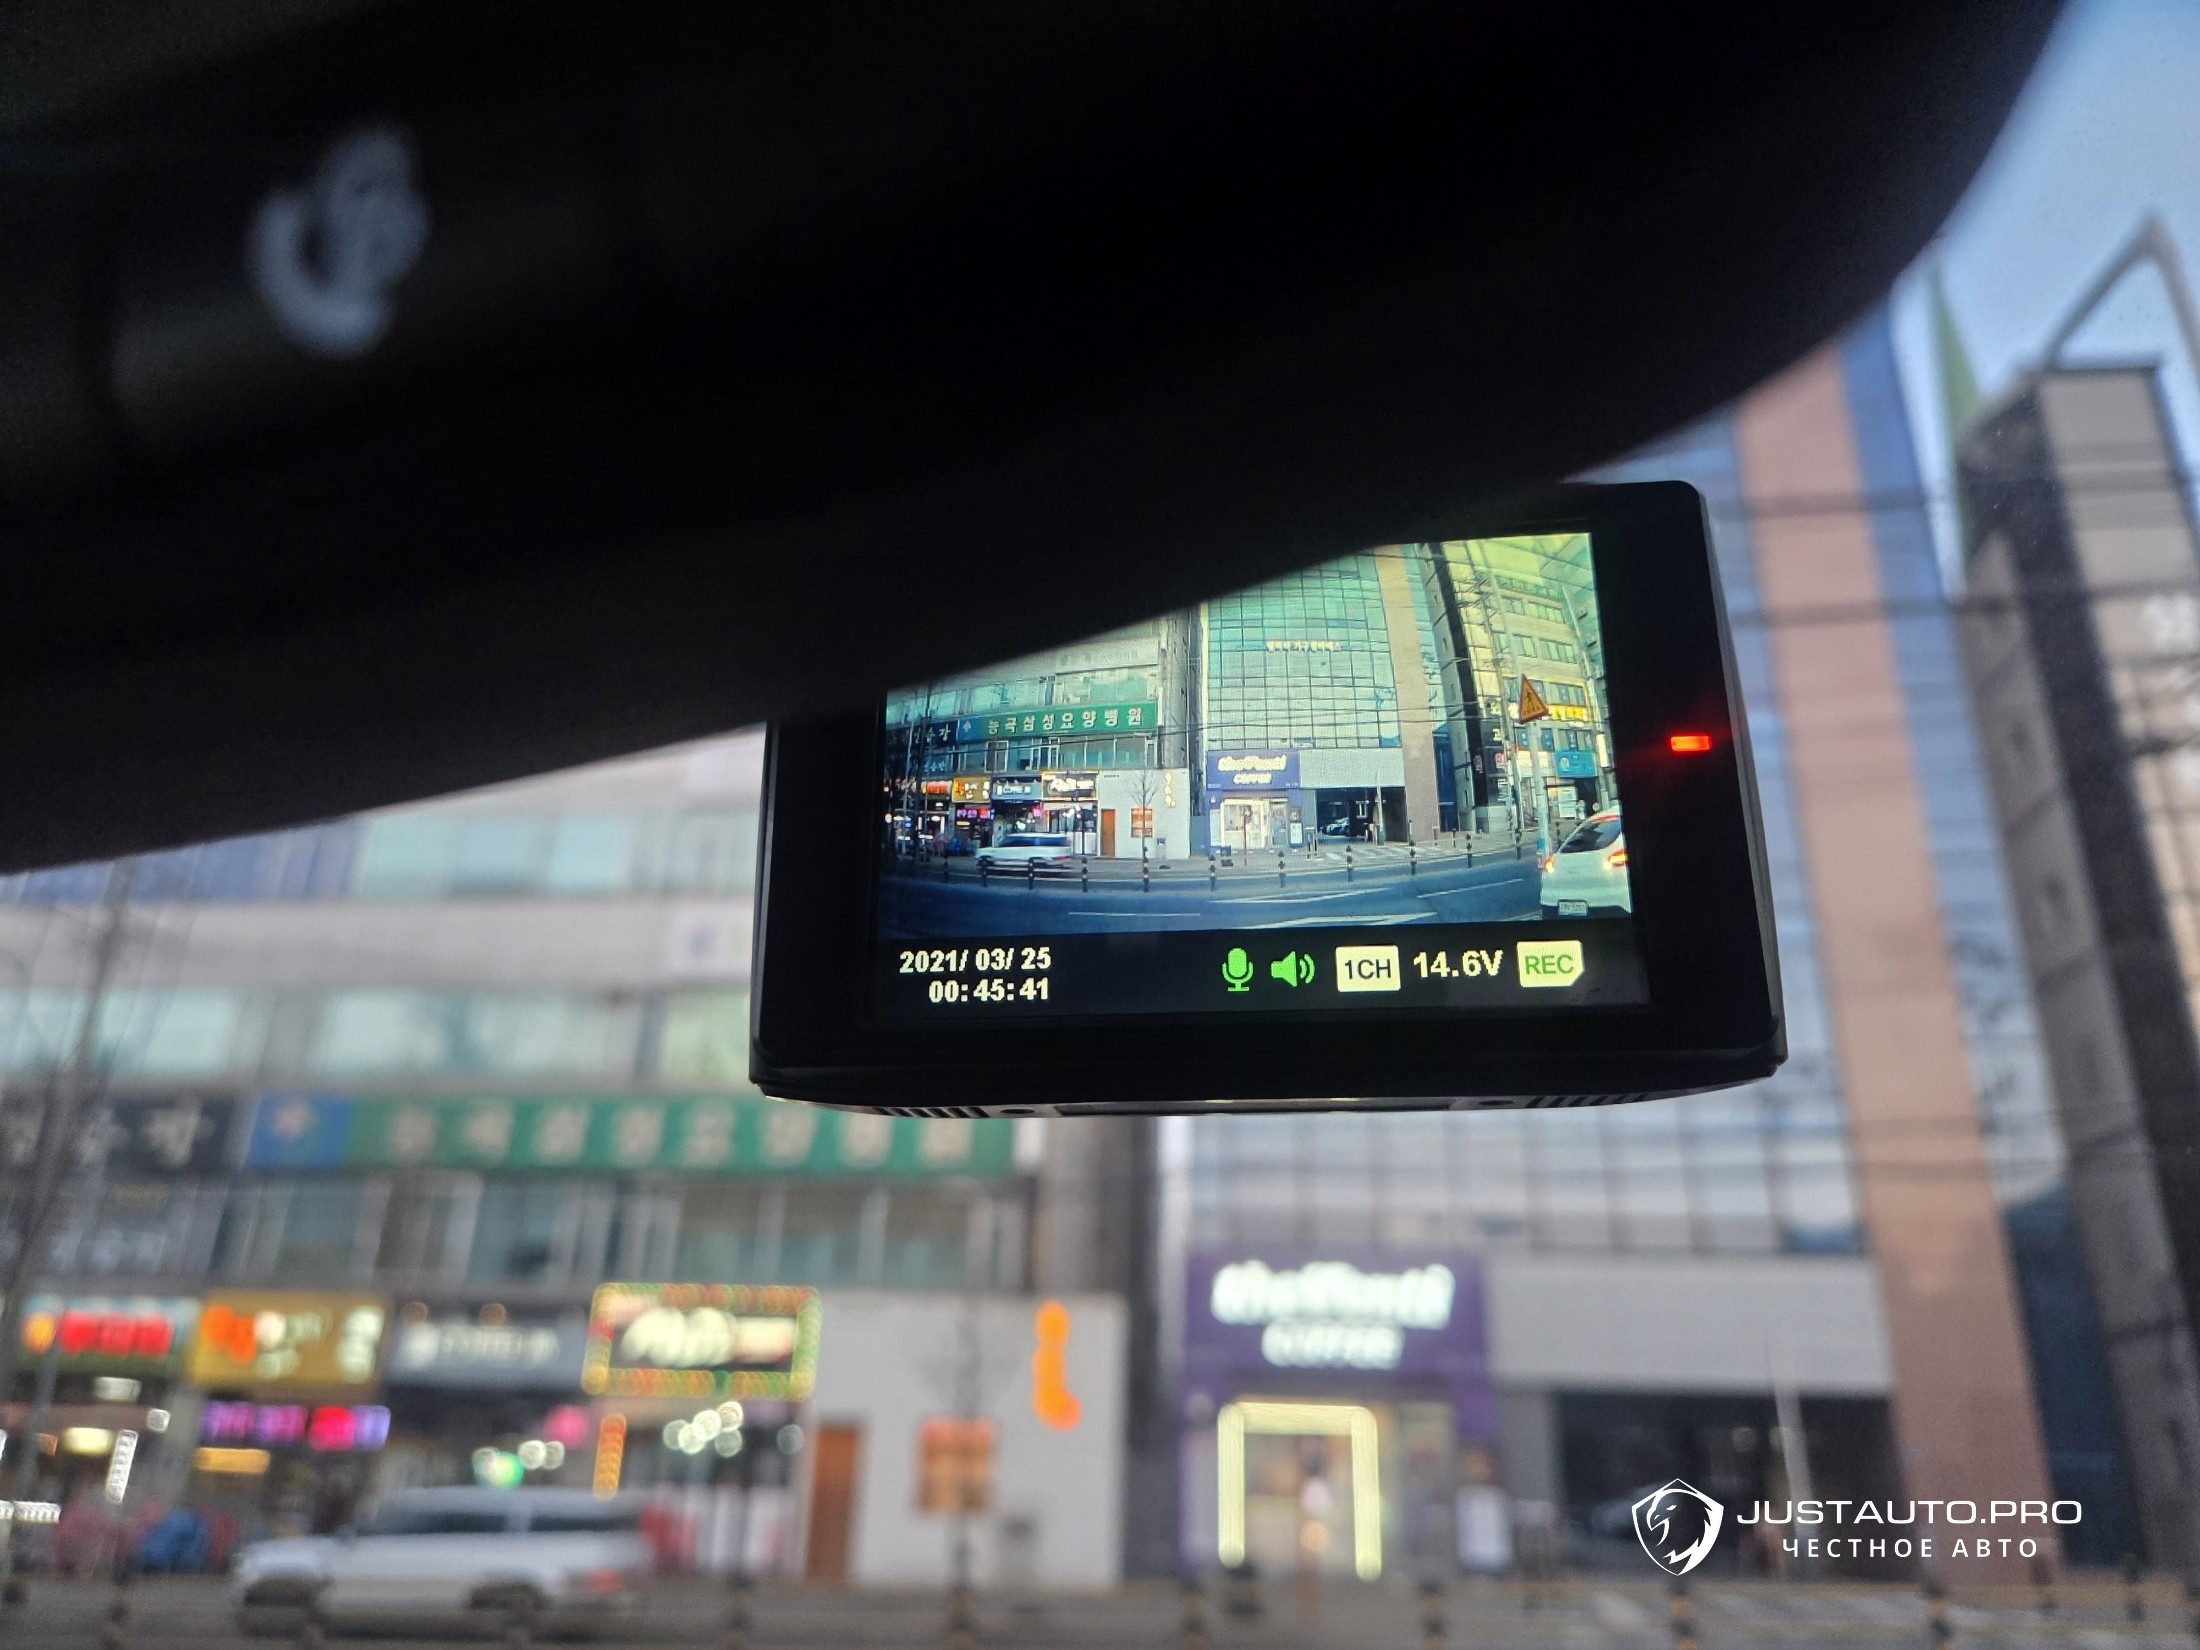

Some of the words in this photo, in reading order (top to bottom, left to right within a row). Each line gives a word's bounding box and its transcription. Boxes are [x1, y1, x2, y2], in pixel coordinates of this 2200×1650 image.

[1344, 959, 1392, 980] 1CH
[1413, 949, 1503, 978] 14.6V
[1524, 953, 1575, 975] REC
[928, 977, 1049, 1003] 00:45:41
